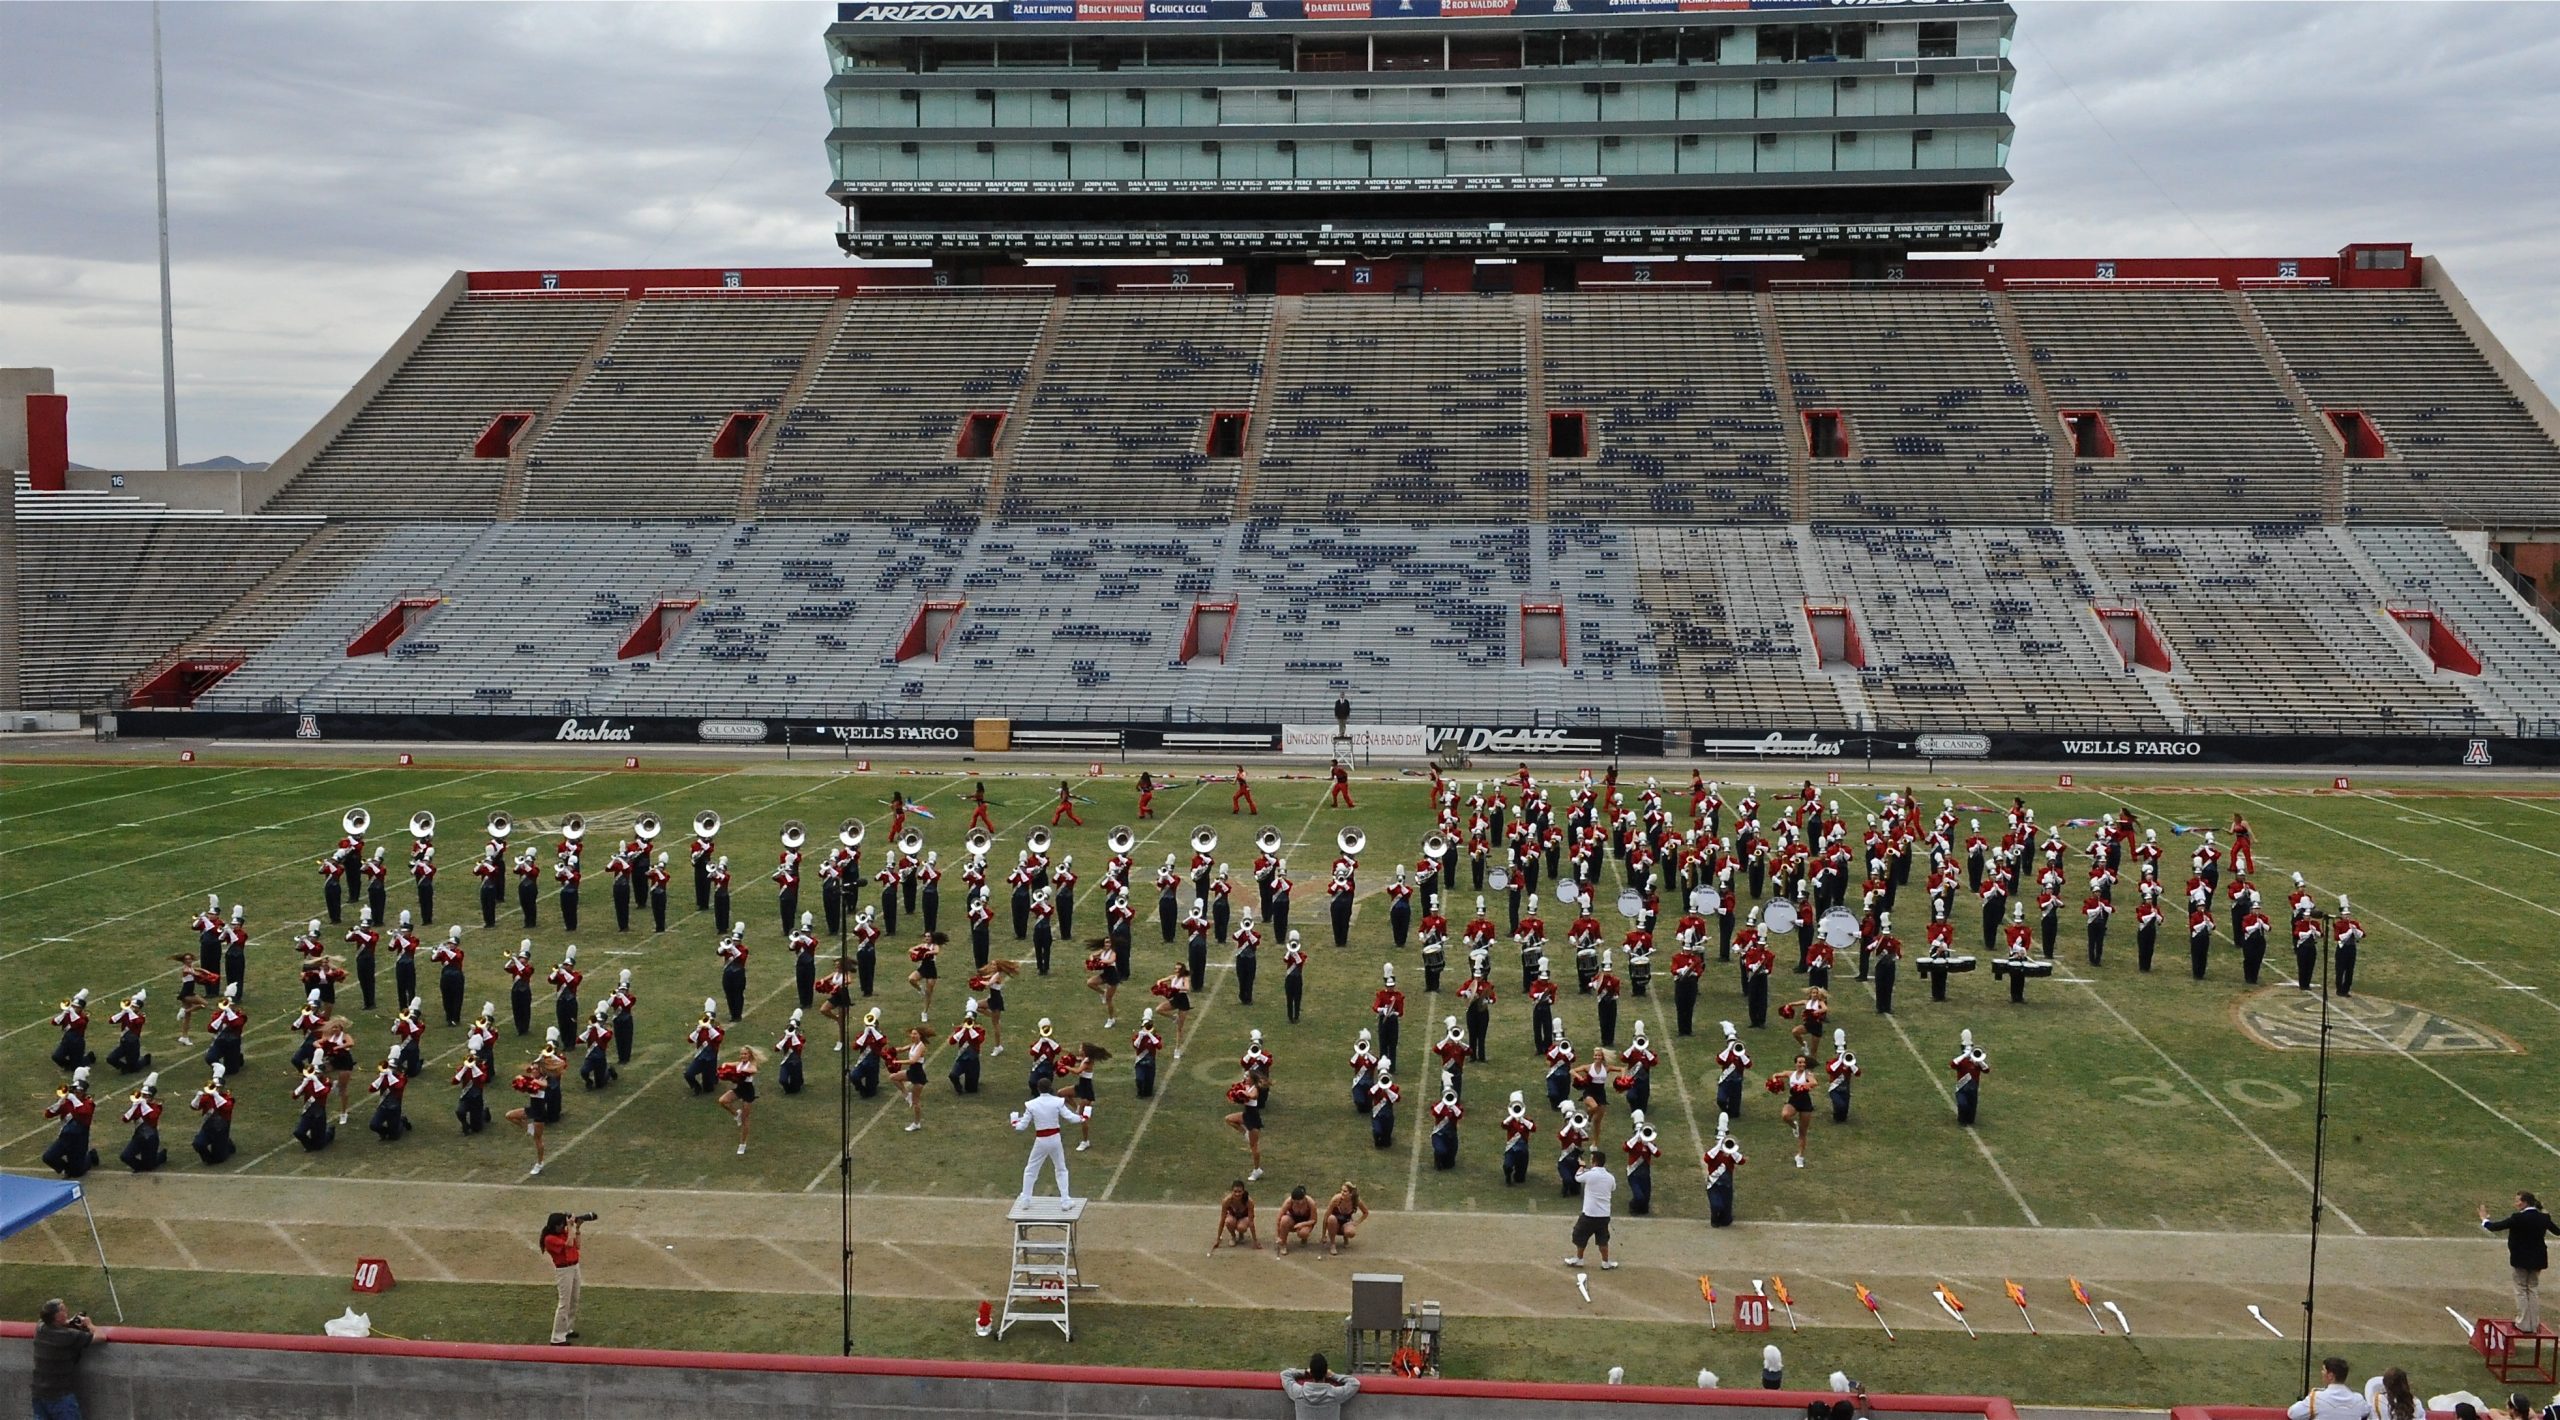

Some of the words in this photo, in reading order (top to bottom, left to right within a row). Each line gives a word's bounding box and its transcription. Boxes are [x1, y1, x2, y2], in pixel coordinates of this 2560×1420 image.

[1013, 5, 1023, 14] 22
[1025, 6, 1038, 14] ART
[1040, 6, 1073, 14] LUPPINO
[1089, 5, 1111, 14] RICKY
[1114, 5, 1143, 14] HUNLEY
[1157, 5, 1183, 14] CHUCK
[1186, 5, 1207, 13] CECIL
[1305, 3, 1310, 12] 4
[1312, 3, 1345, 12] DARRYLL
[1347, 3, 1370, 11] LEWIS
[1453, 1, 1468, 9] ROB
[1471, 0, 1508, 8] WALDROP
[855, 4, 993, 21] ARIZONA
[1635, 272, 1650, 281] 22
[1888, 270, 1903, 279] 23
[2098, 268, 2114, 279] 24
[2280, 267, 2297, 277] 25
[725, 278, 739, 287] 18
[934, 275, 947, 286] 19
[1173, 274, 1188, 285] 20
[1356, 272, 1369, 283] 21
[544, 279, 556, 289] 17
[112, 476, 123, 486] 16
[555, 718, 634, 740] Bashas'
[705, 726, 722, 734] SOL
[724, 726, 760, 734] CASINOS
[832, 727, 896, 739] WELLS
[898, 727, 959, 740] FARGO
[1286, 734, 1329, 745] UNIVERSITY
[1346, 734, 1379, 745] RIZONA
[1382, 734, 1404, 745] BAND
[1406, 734, 1422, 745] DAY
[1922, 740, 1940, 748] SOL
[1943, 740, 1984, 749] CASINOS
[2062, 740, 2130, 753] WELLS
[2134, 742, 2201, 755] FARGO
[182, 752, 191, 760] G
[2338, 779, 2347, 788] 10
[356, 1264, 378, 1288] 40
[1042, 1281, 1059, 1300] 50
[1740, 1301, 1763, 1326] 40
